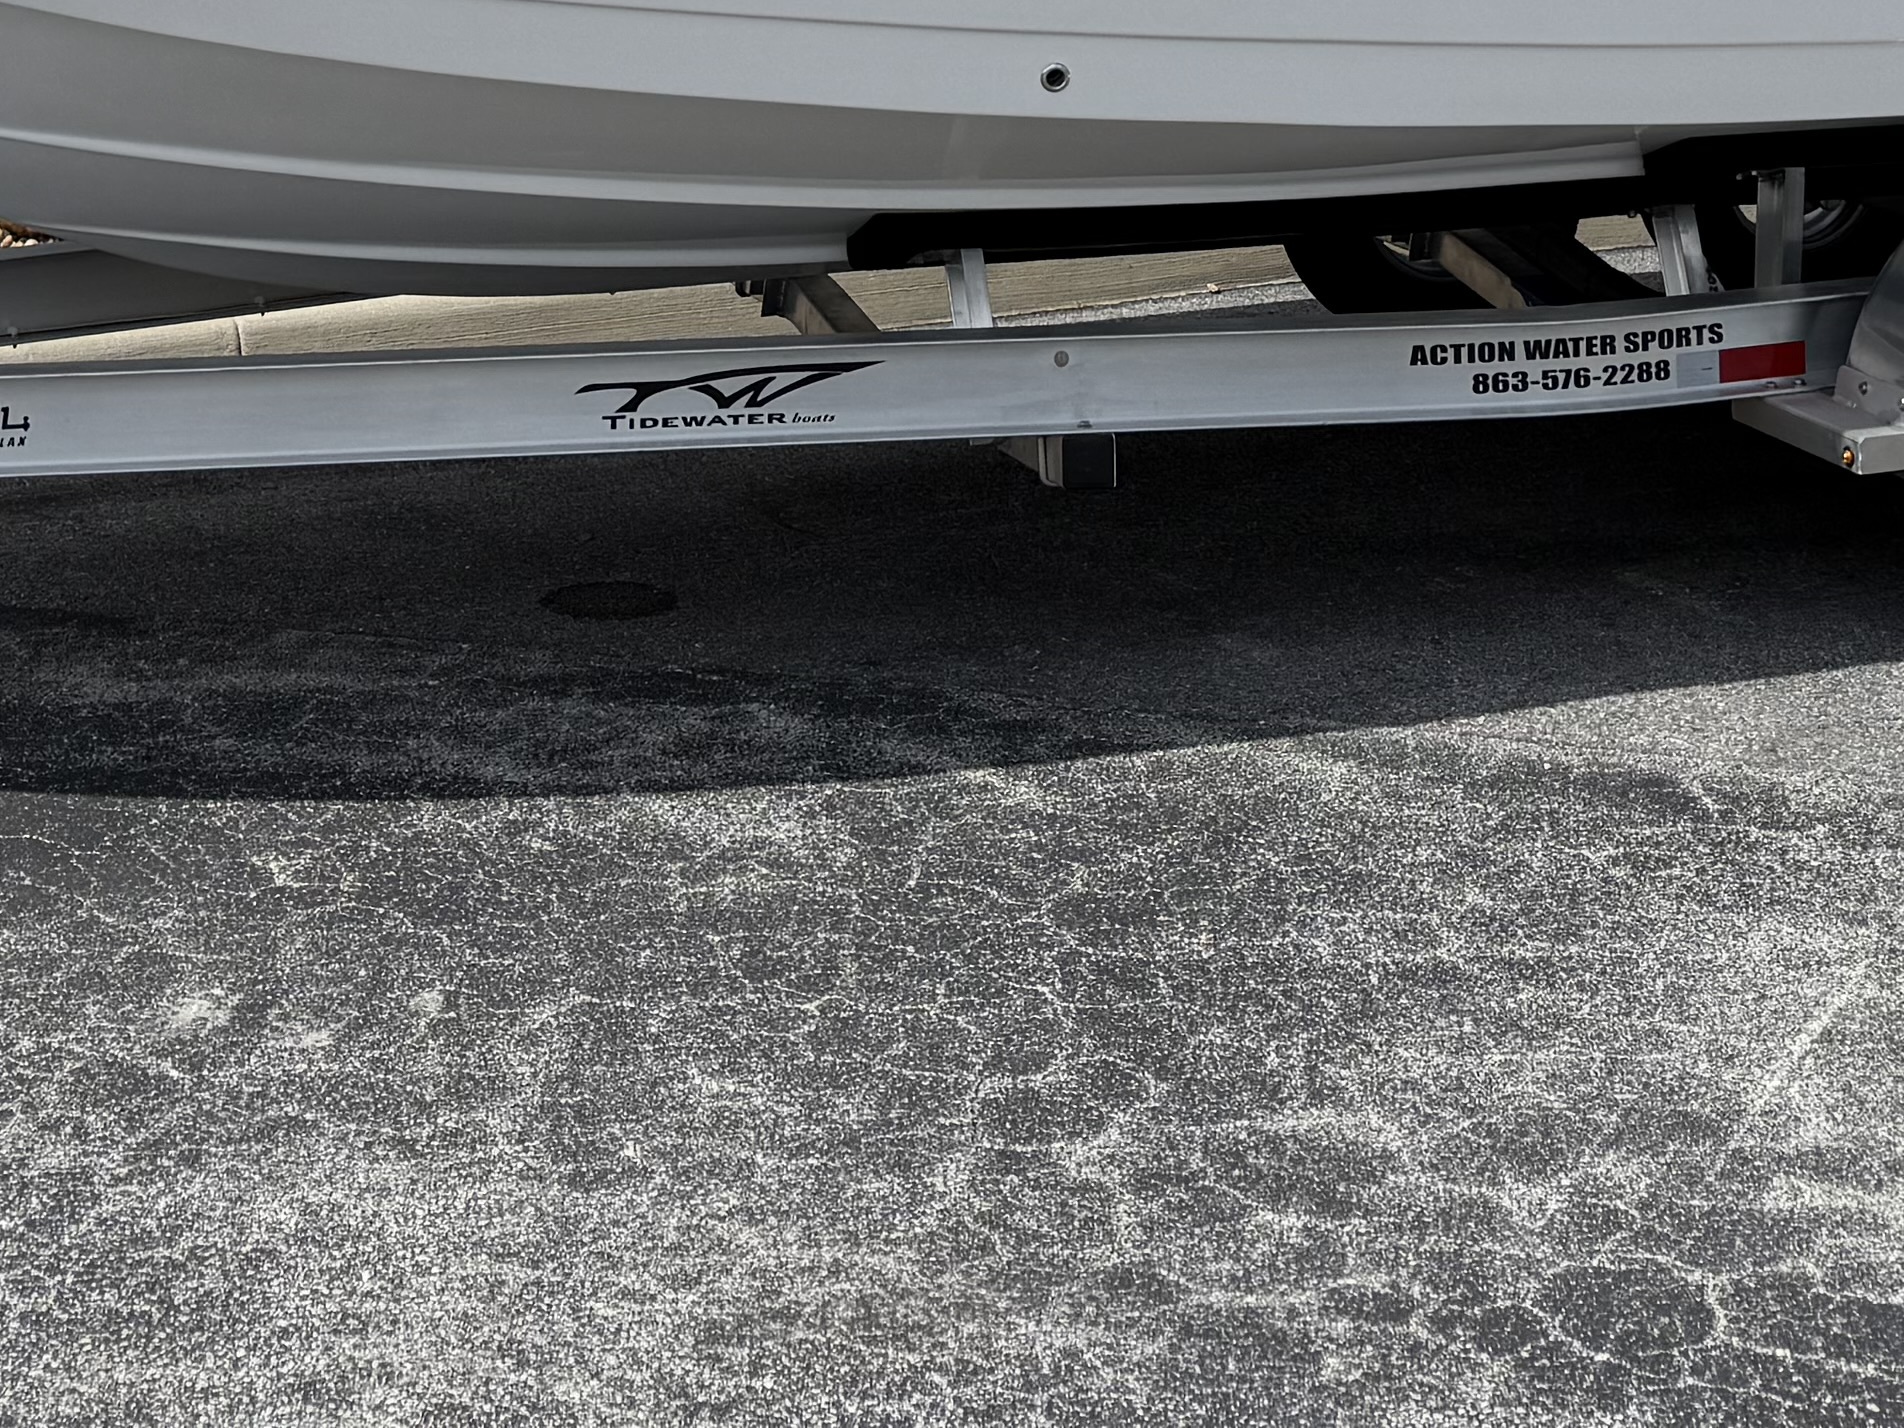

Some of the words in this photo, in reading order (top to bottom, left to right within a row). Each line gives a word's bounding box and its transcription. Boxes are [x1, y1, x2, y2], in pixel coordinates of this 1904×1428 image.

[1409, 341, 1516, 366] ACTION
[1523, 333, 1617, 362] WATER
[1623, 322, 1725, 355] SPORTS
[1471, 359, 1672, 395] 863-576-2288
[601, 412, 788, 431] TIDEWATER
[791, 412, 837, 425] boats
